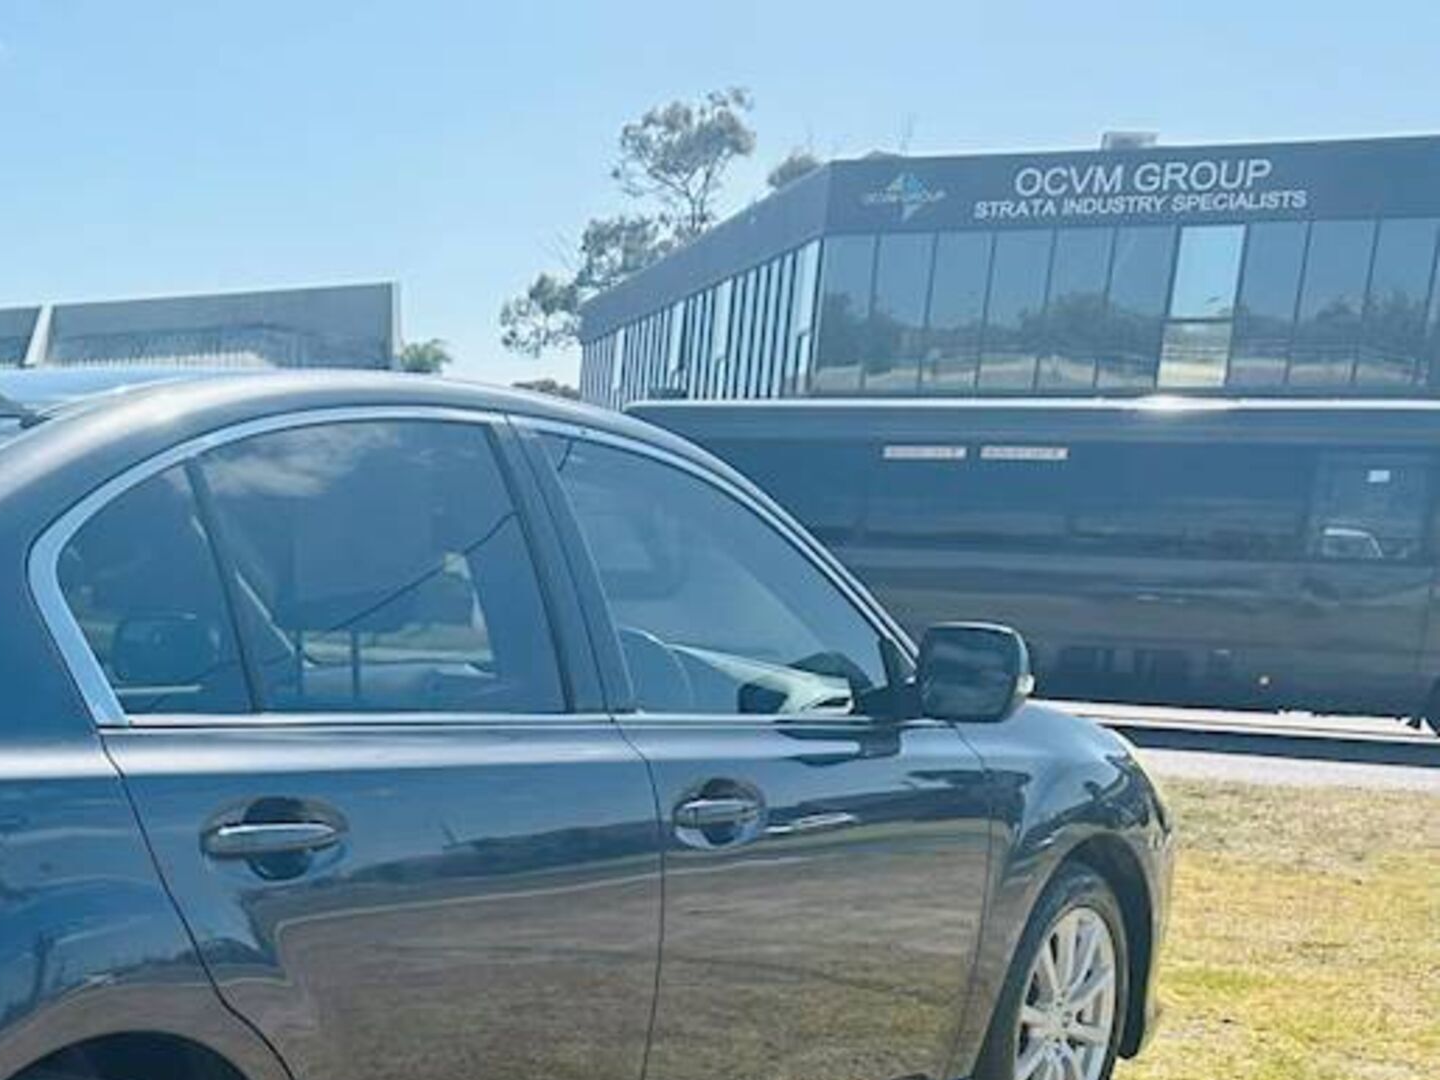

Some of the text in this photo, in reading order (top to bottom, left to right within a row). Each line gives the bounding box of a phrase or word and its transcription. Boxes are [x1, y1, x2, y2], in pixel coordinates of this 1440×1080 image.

[1014, 158, 1272, 197] OCVM GROUP
[973, 190, 1307, 219] STRATA INDUSTRY SPECIALISTS
